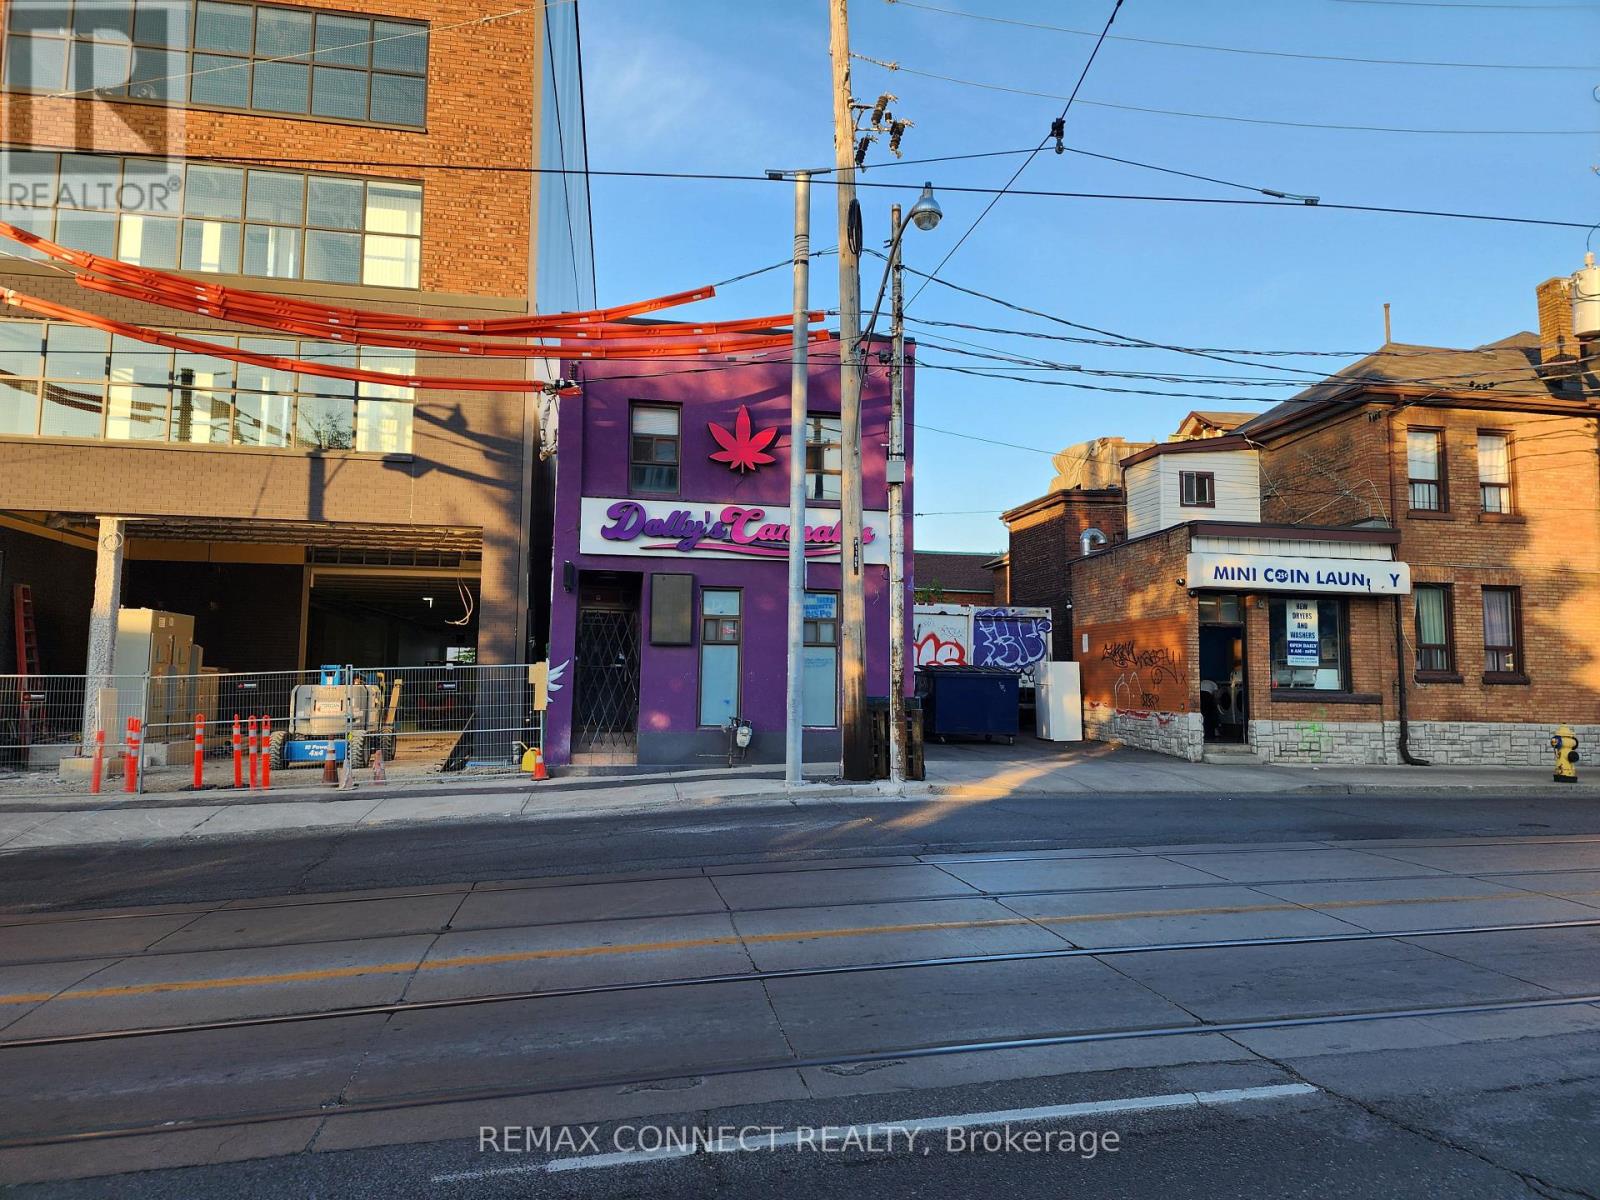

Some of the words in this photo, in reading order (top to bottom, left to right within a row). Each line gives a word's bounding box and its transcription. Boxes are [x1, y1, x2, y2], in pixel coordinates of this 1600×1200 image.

[600, 501, 729, 552] Dolly's
[1213, 565, 1257, 581] MINI
[1291, 612, 1313, 620] DRYERS
[1289, 631, 1316, 639] WASHERS
